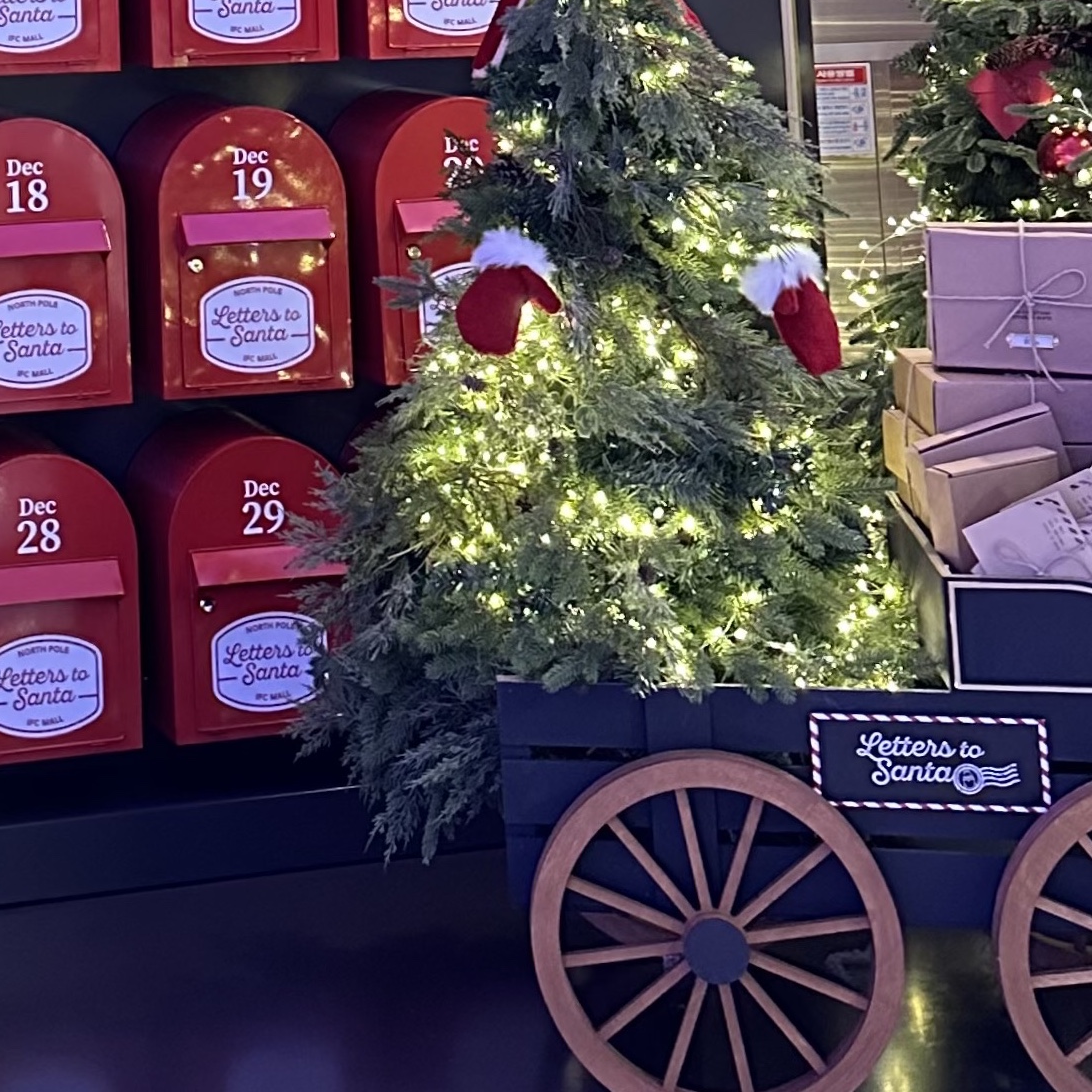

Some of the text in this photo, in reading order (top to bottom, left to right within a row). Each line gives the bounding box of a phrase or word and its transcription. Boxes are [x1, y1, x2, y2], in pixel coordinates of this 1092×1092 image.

[245, 25, 264, 33] MALL
[457, 17, 477, 25] MALL
[24, 33, 44, 42] MALL
[233, 148, 268, 165] Dec
[6, 159, 43, 176] Dec
[232, 167, 272, 201] 19
[6, 179, 48, 213] 18
[233, 287, 282, 296] NORTH POLE
[8, 301, 35, 310] NORTH
[211, 305, 301, 328] Letters to
[60, 321, 78, 335] to
[230, 324, 288, 347] Santa
[4, 340, 64, 362] Santa
[258, 353, 278, 361] MALL
[32, 368, 53, 377] MALL
[243, 480, 280, 499] Dec
[19, 499, 56, 516] Dec
[242, 500, 284, 535] 29
[17, 519, 61, 554] 28
[246, 622, 273, 633] NORTH
[18, 646, 70, 658] NORTH POLE
[223, 643, 313, 667] Letters to
[72, 669, 90, 683] to
[242, 663, 302, 685] Santa
[13, 688, 76, 711] Santa
[42, 716, 64, 726] MALL
[856, 732, 985, 763] Letters to
[871, 758, 955, 786] Santa
